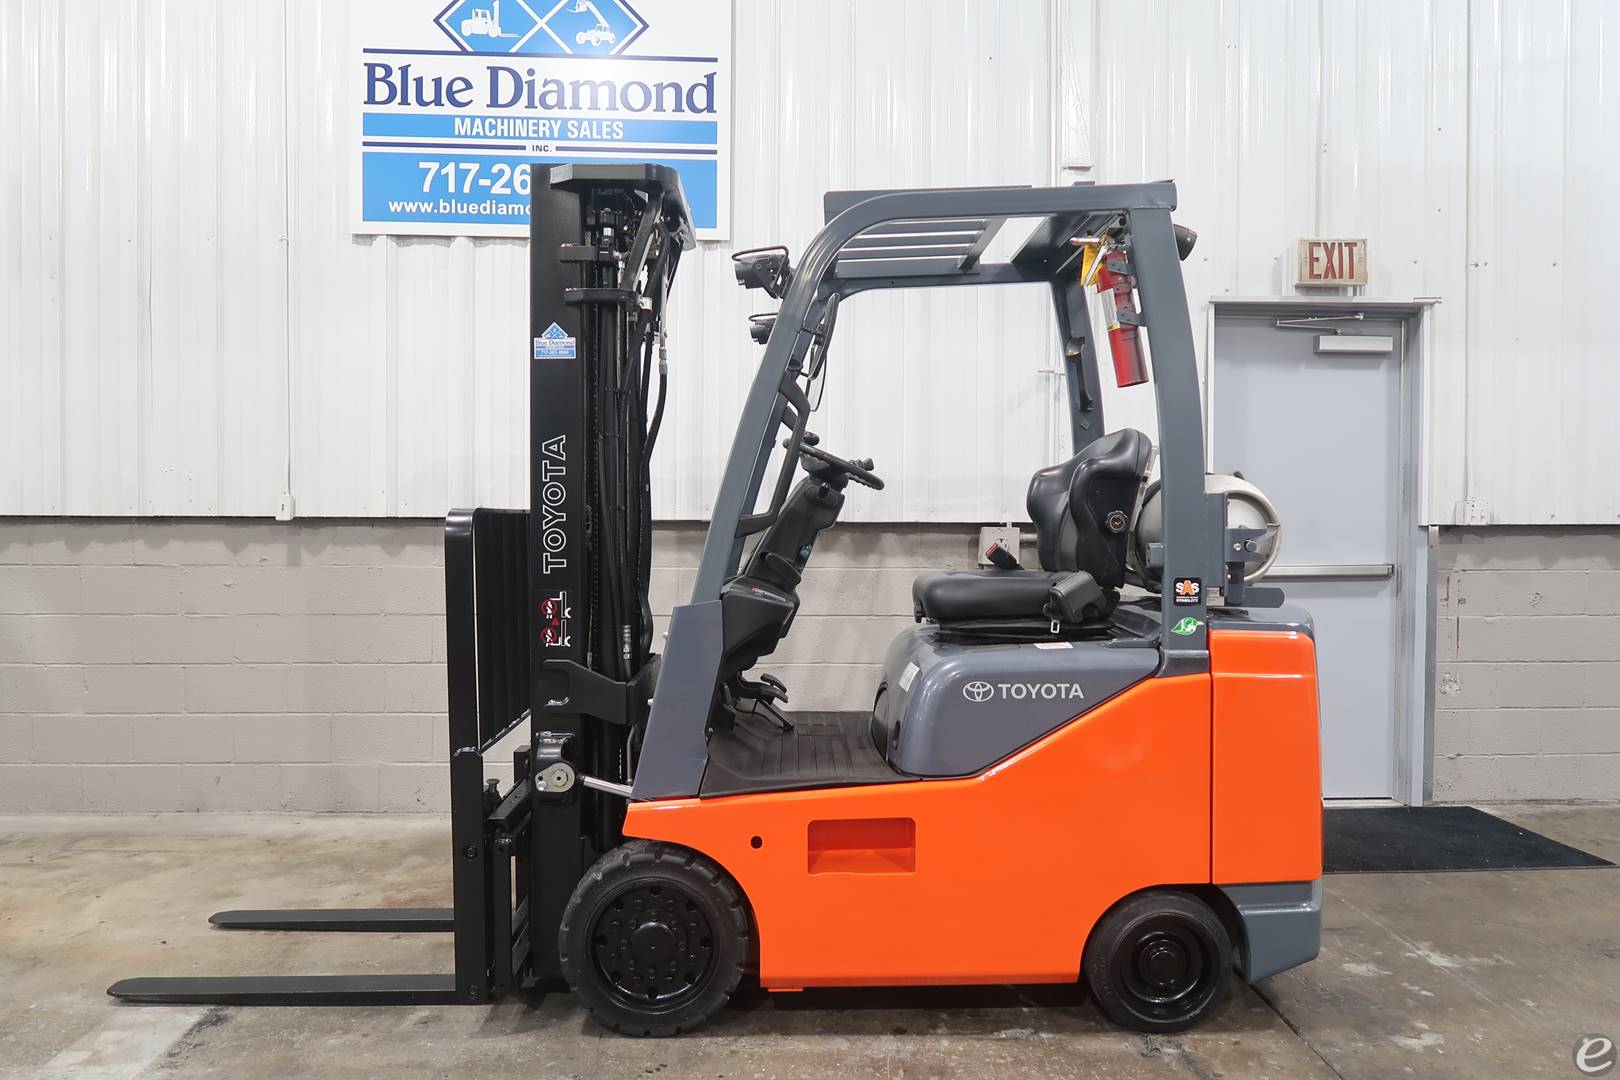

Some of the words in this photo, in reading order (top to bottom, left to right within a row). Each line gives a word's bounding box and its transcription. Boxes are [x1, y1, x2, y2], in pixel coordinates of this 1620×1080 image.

[363, 62, 474, 108] Blue
[486, 65, 718, 114] Diamond
[454, 116, 561, 138] MACHINERY
[567, 119, 624, 140] SALES
[531, 144, 553, 153] INC.
[1308, 241, 1358, 280] EXIT
[542, 434, 567, 574] TOYOTA
[1175, 579, 1200, 595] SAS
[998, 683, 1085, 700] TOYOTA
